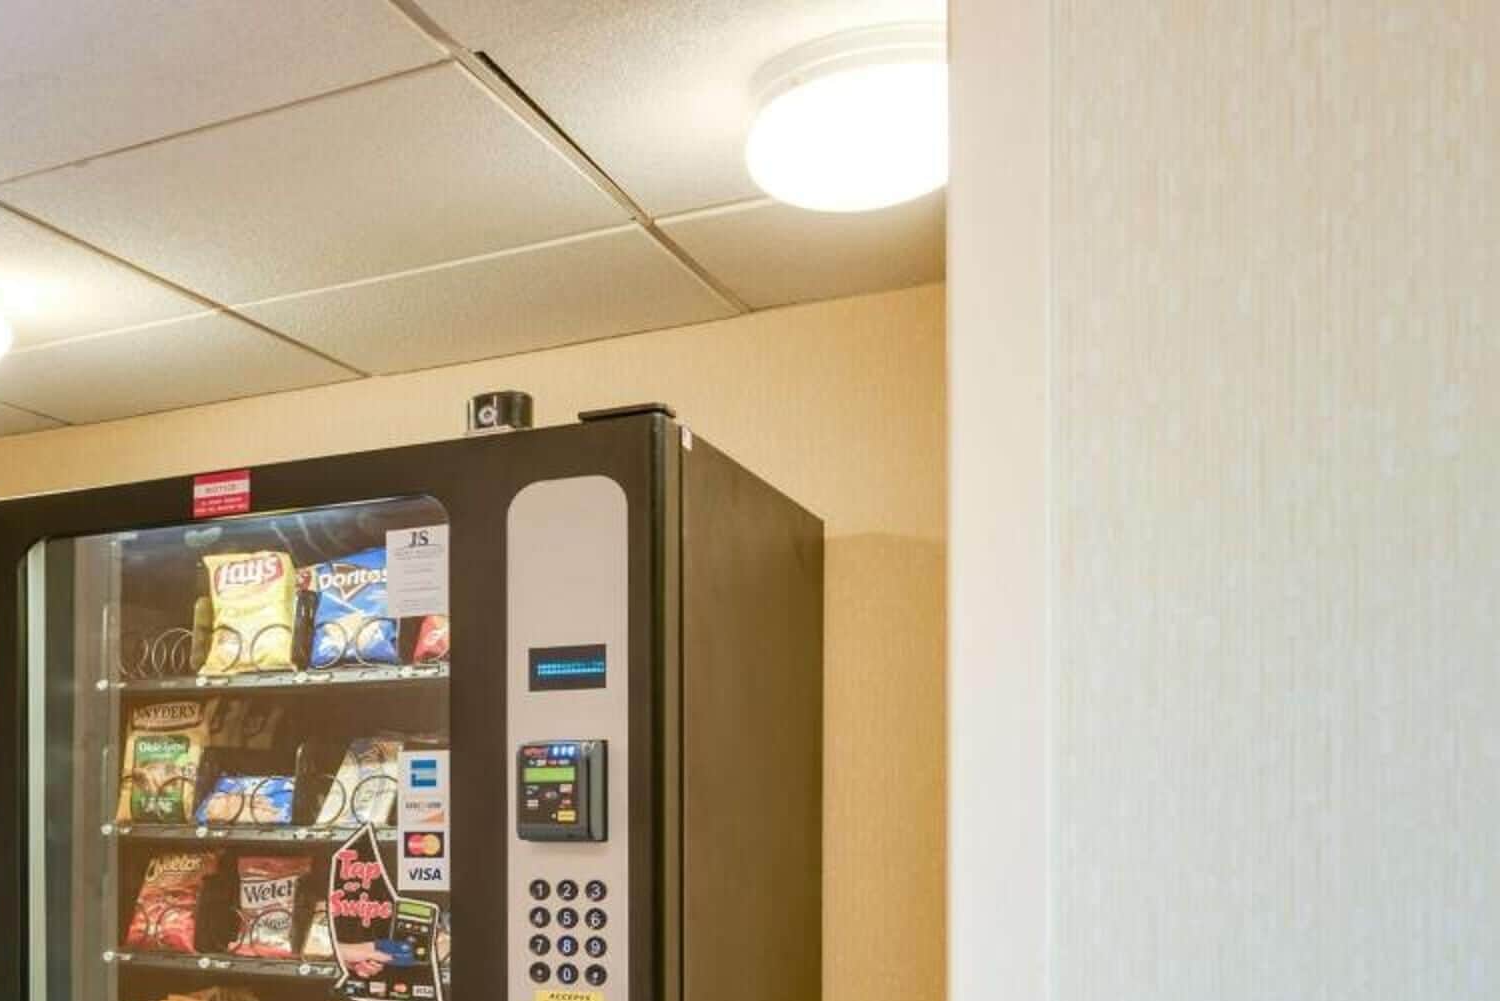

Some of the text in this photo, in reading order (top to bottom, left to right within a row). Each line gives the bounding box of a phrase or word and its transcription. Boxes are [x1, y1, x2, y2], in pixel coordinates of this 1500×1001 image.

[337, 849, 382, 889] Tap
[408, 867, 442, 881] VISA
[537, 884, 544, 897] 1
[563, 884, 572, 897] 2
[591, 884, 600, 898] 3
[329, 888, 392, 927] Swipe
[534, 911, 542, 924] 4
[563, 911, 571, 925] 5
[591, 912, 600, 927] 6
[535, 940, 543, 953] 7
[562, 938, 571, 953] 8
[590, 940, 600, 955] 9
[563, 967, 571, 982] 0
